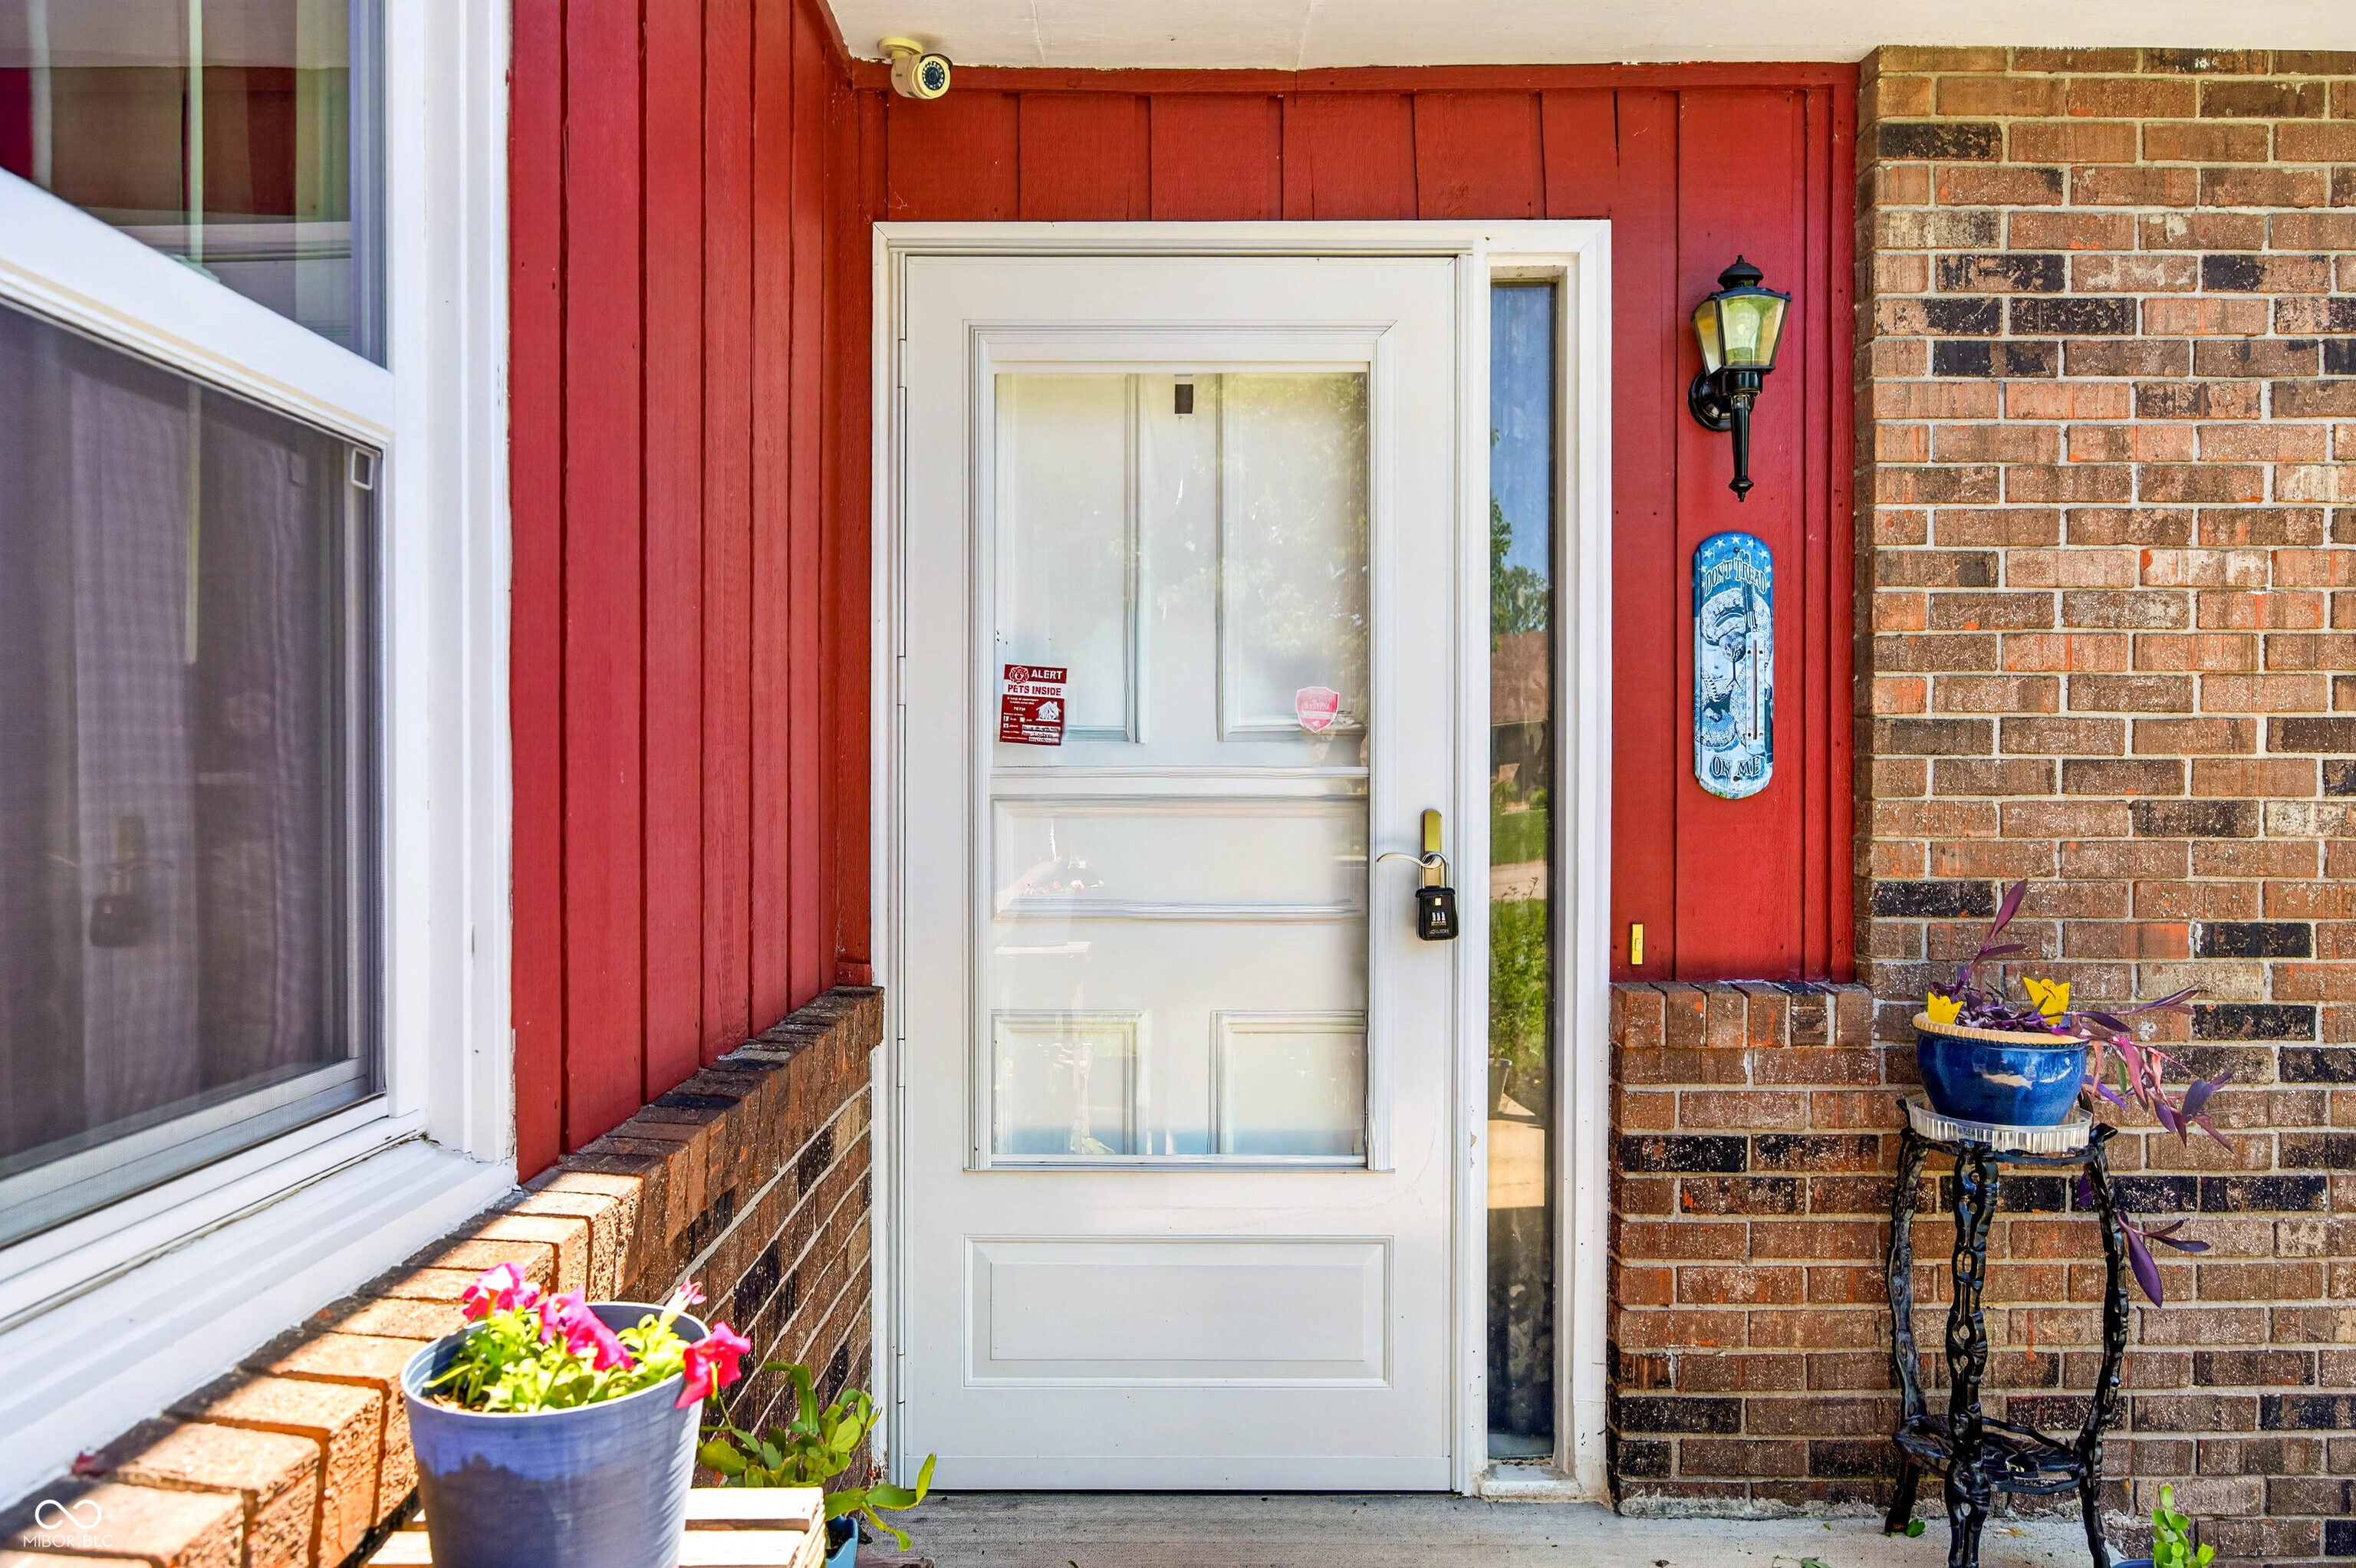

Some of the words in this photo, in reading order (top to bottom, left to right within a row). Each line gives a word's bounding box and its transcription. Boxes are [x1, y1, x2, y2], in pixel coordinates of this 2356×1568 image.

[1733, 557, 1767, 594] TREAD
[1031, 669, 1062, 679] ALERT
[1008, 684, 1029, 694] PETS
[1032, 686, 1061, 695] INSIDE
[1711, 755, 1732, 779] ON
[1736, 755, 1761, 776] ME
